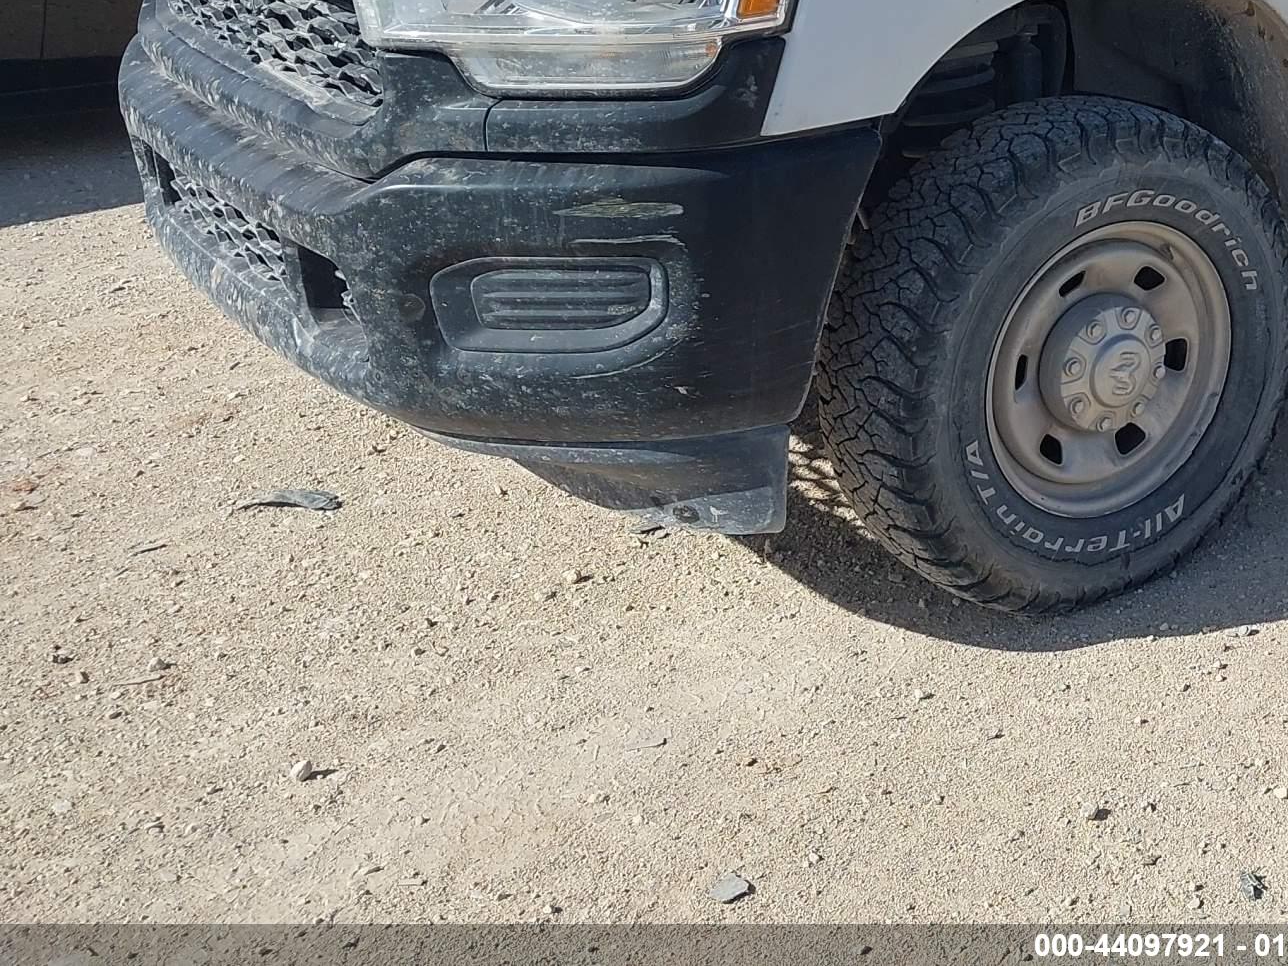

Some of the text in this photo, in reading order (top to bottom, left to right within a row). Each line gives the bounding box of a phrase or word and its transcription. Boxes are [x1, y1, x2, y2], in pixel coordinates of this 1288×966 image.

[1073, 189, 1259, 291] BFGoodrich
[965, 439, 1186, 553] All-Terrain T/A
